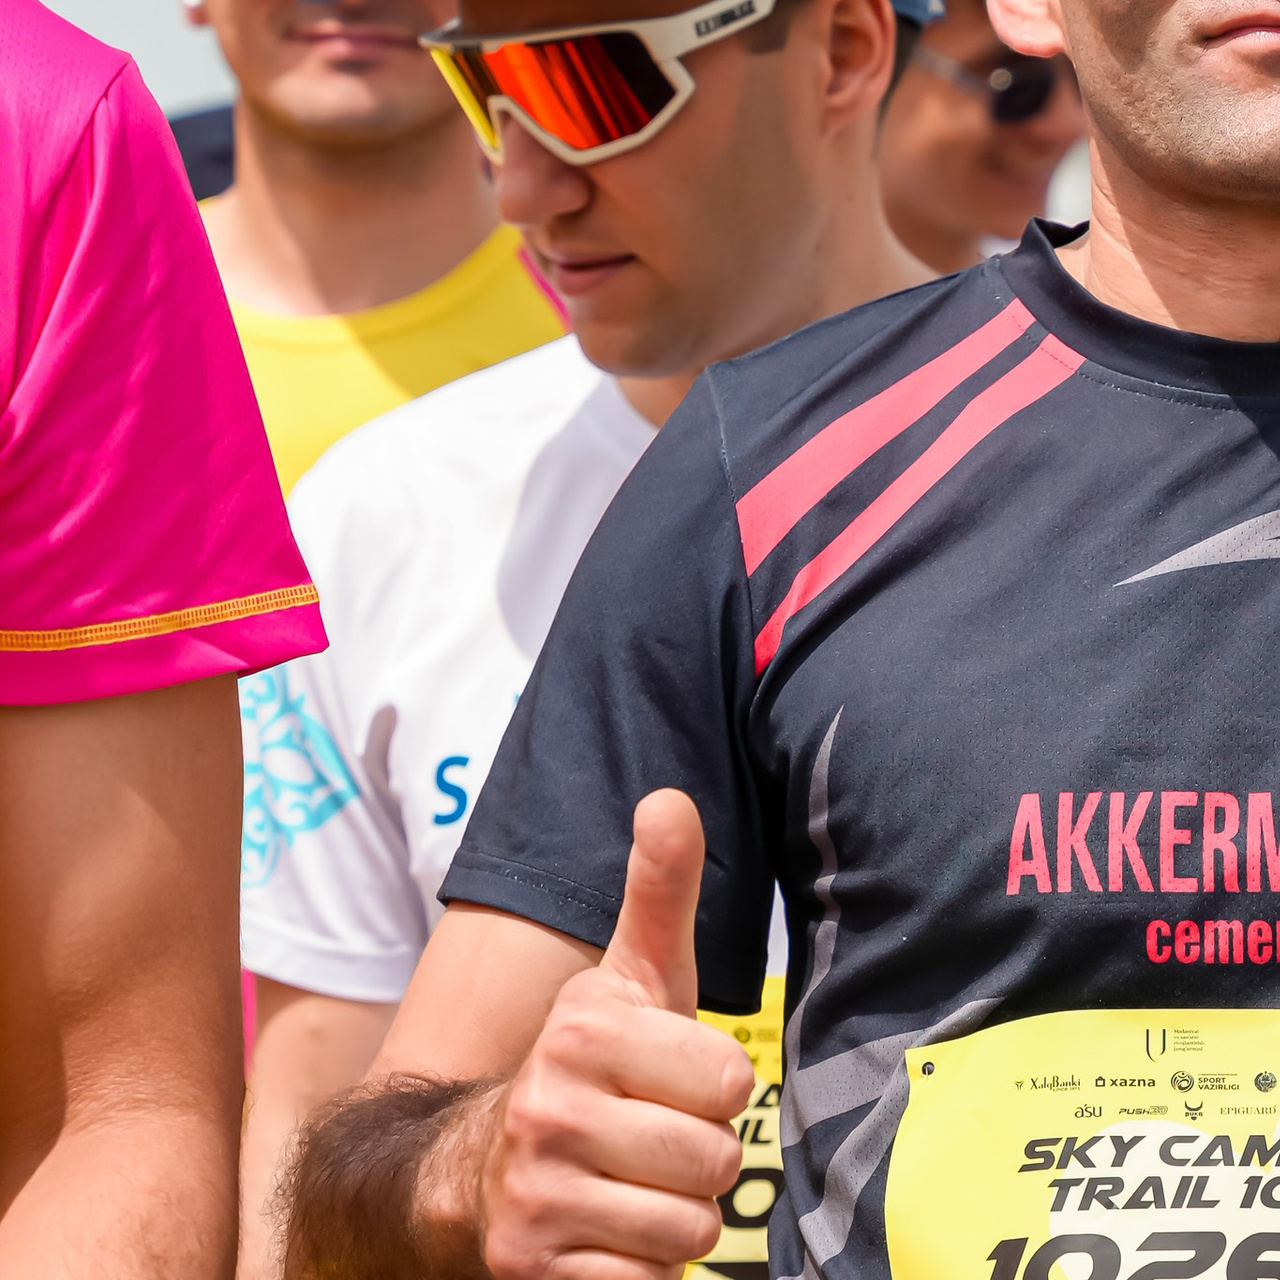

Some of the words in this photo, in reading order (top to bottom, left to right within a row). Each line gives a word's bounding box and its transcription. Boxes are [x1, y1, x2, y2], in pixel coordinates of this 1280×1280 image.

[1110, 1078, 1156, 1087] xazna
[1220, 1107, 1276, 1115] EPIGUARD
[1017, 1135, 1146, 1172] SKY
[1047, 1176, 1222, 1212] TRAIL
